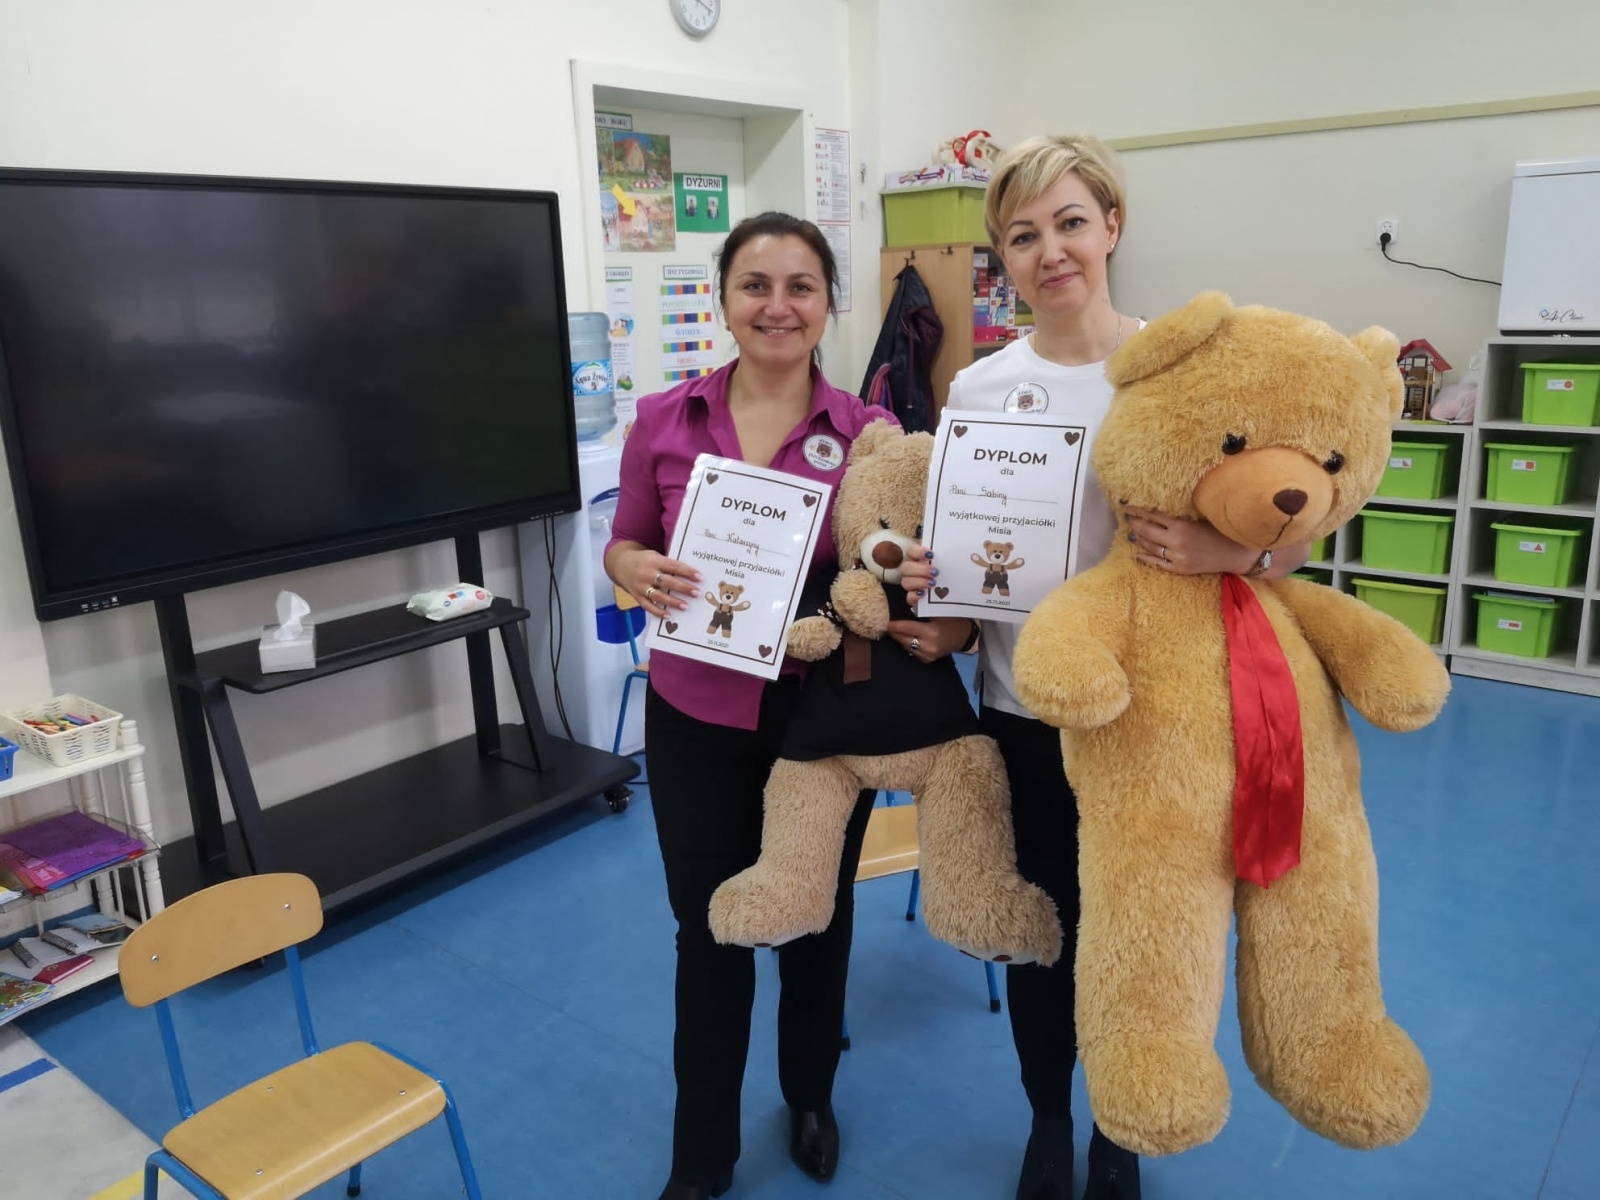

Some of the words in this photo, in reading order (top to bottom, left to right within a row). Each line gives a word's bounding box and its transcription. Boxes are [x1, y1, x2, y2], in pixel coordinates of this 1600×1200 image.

[685, 174, 721, 189] DYŻURNI
[973, 448, 1047, 466] DYPLOM
[1000, 467, 1014, 476] dla
[981, 485, 1007, 508] Sabiny
[721, 496, 787, 522] DYPLOM
[742, 516, 756, 526] dla
[949, 510, 1001, 524] wyjątkowej
[1002, 515, 1056, 529] przyjaciółki
[988, 526, 1012, 536] Misia
[692, 549, 738, 567] wyjątkowej
[738, 559, 786, 578] przyjaciółki
[724, 568, 745, 580] Misia
